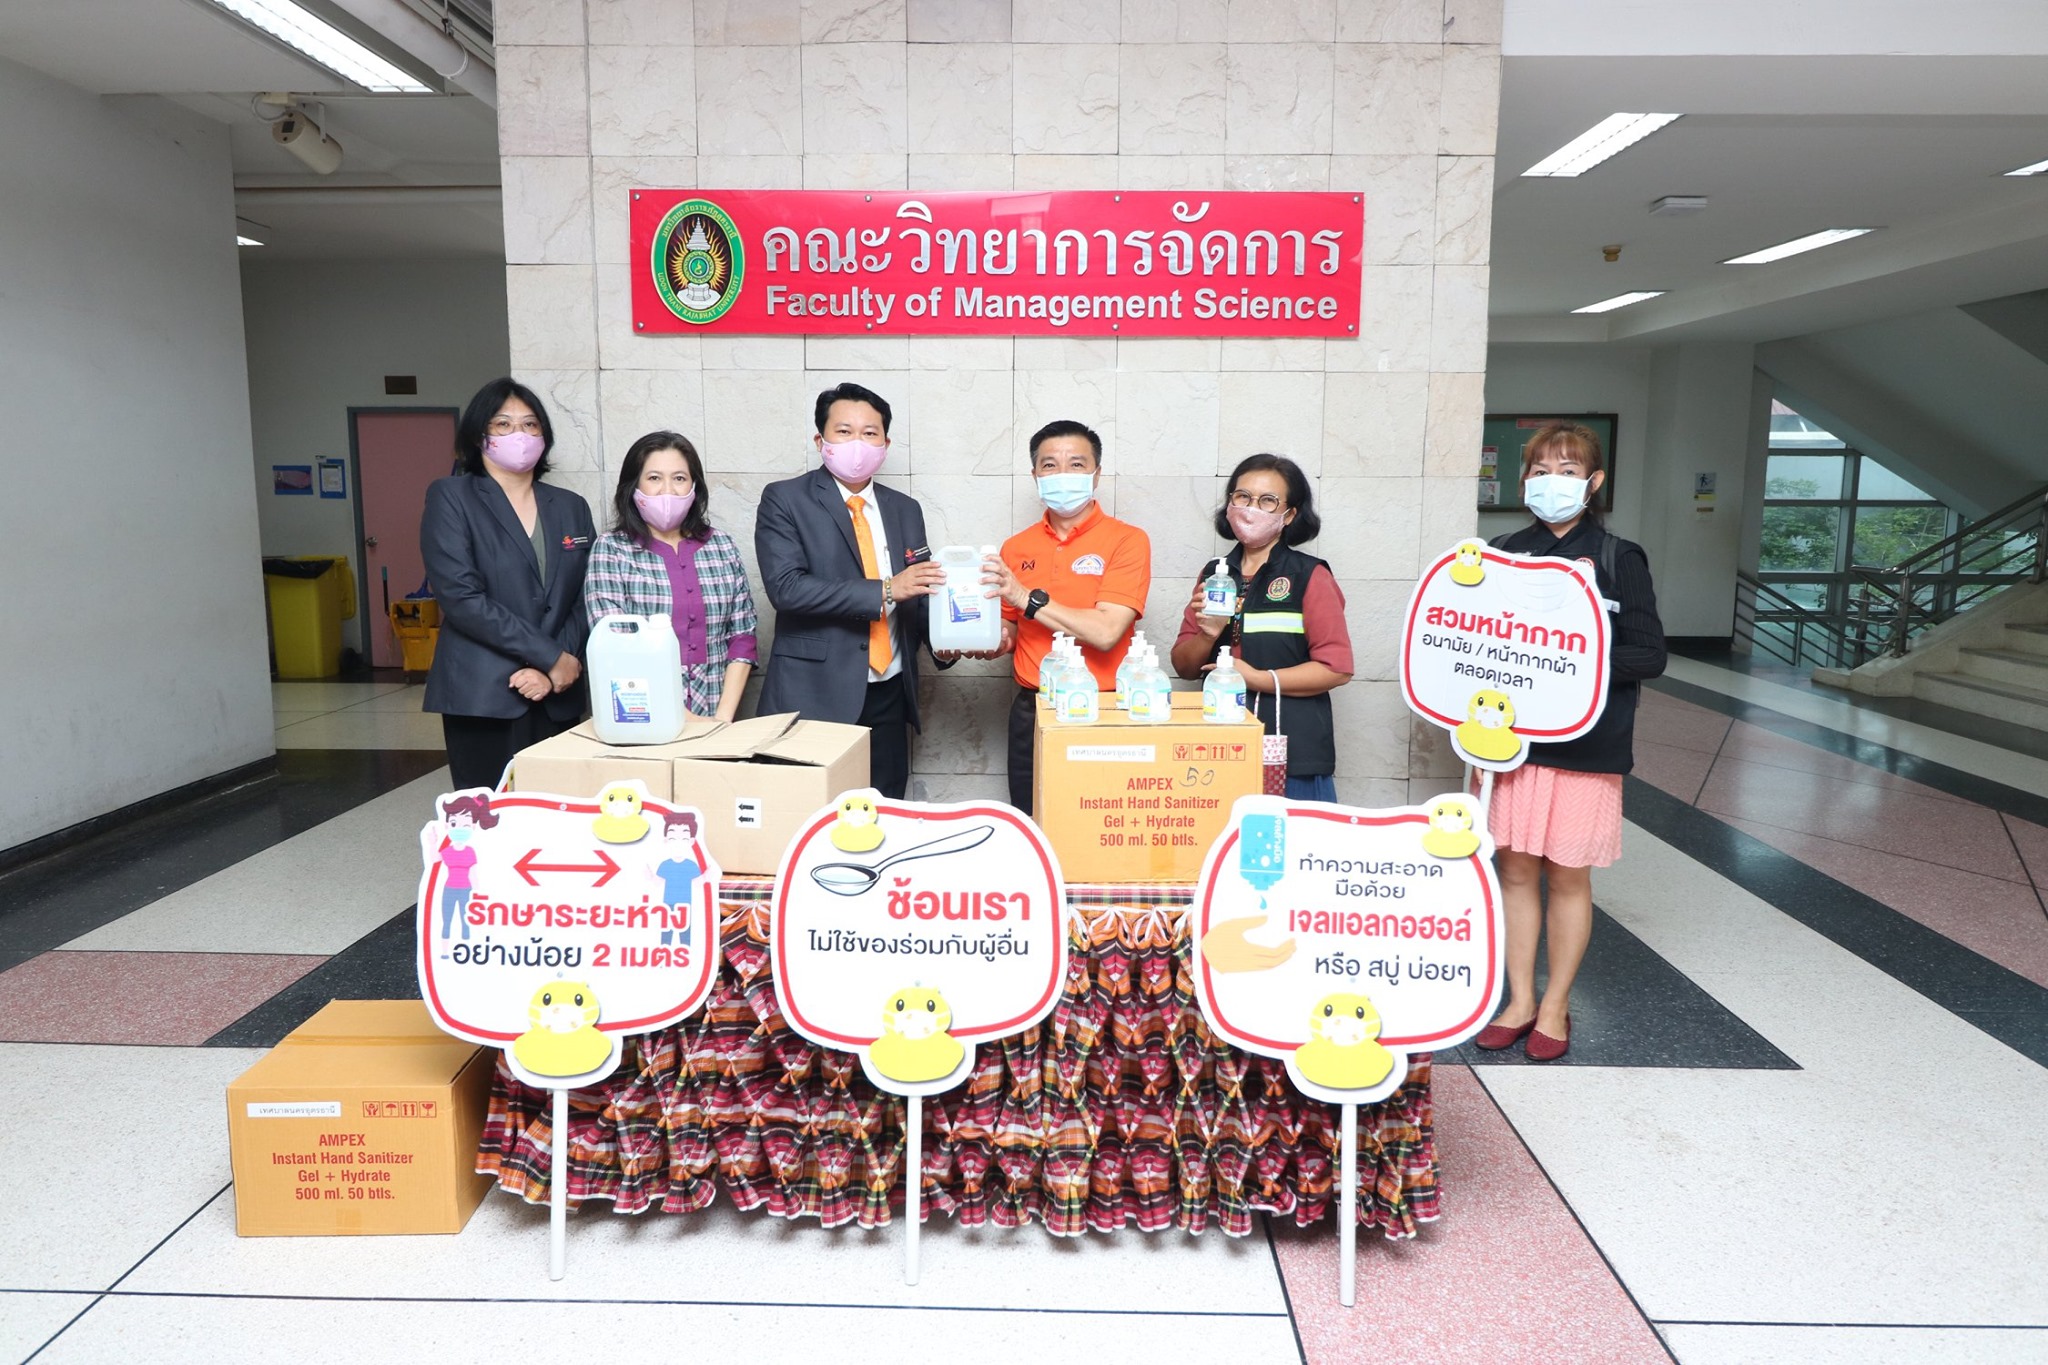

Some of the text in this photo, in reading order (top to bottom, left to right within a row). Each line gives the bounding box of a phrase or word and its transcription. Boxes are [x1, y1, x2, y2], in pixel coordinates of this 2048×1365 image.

[762, 200, 1343, 276] คณะวิทยาการจัดการ
[657, 272, 740, 320] UDON THANI RAJABHAT UNIVERSITY
[766, 285, 1337, 326] Faculty of Management Science
[1426, 606, 1586, 654] สวมหน้ากาก
[1422, 633, 1472, 654] อนามัย
[1487, 645, 1576, 676] หน้ากากผ้า
[1454, 661, 1533, 690] ตลอดเวลา
[1127, 778, 1173, 790] AMPEX
[1179, 766, 1215, 788] 50
[1080, 796, 1219, 809] Instant Hand Sanitizer
[1104, 815, 1124, 828] Gel
[1146, 815, 1195, 830] Hydrate
[1100, 834, 1198, 846] 500 ml. 50 btls.
[1299, 853, 1443, 877] ทำความสะอาด
[887, 877, 1030, 921] ช้อนเรา
[1336, 879, 1405, 898] มือด้วย
[467, 894, 688, 929] รักษาระยะห่าง
[1289, 908, 1471, 941] เจลแอลกอฮอล์
[453, 936, 690, 967] อย่างน้อย 2 เมตร
[808, 928, 1029, 962] ไม่ใช้ของร่วมกับผู้อื่น
[1315, 952, 1471, 987] หรือ สบู่ บ่อยๆ
[319, 1134, 366, 1146] AMPEX
[272, 1151, 413, 1165] Instant Hand Sanitizer
[298, 1170, 319, 1182] Gel
[341, 1170, 390, 1184] Hydrate
[295, 1188, 395, 1200] 500 ml. 50 btls.
